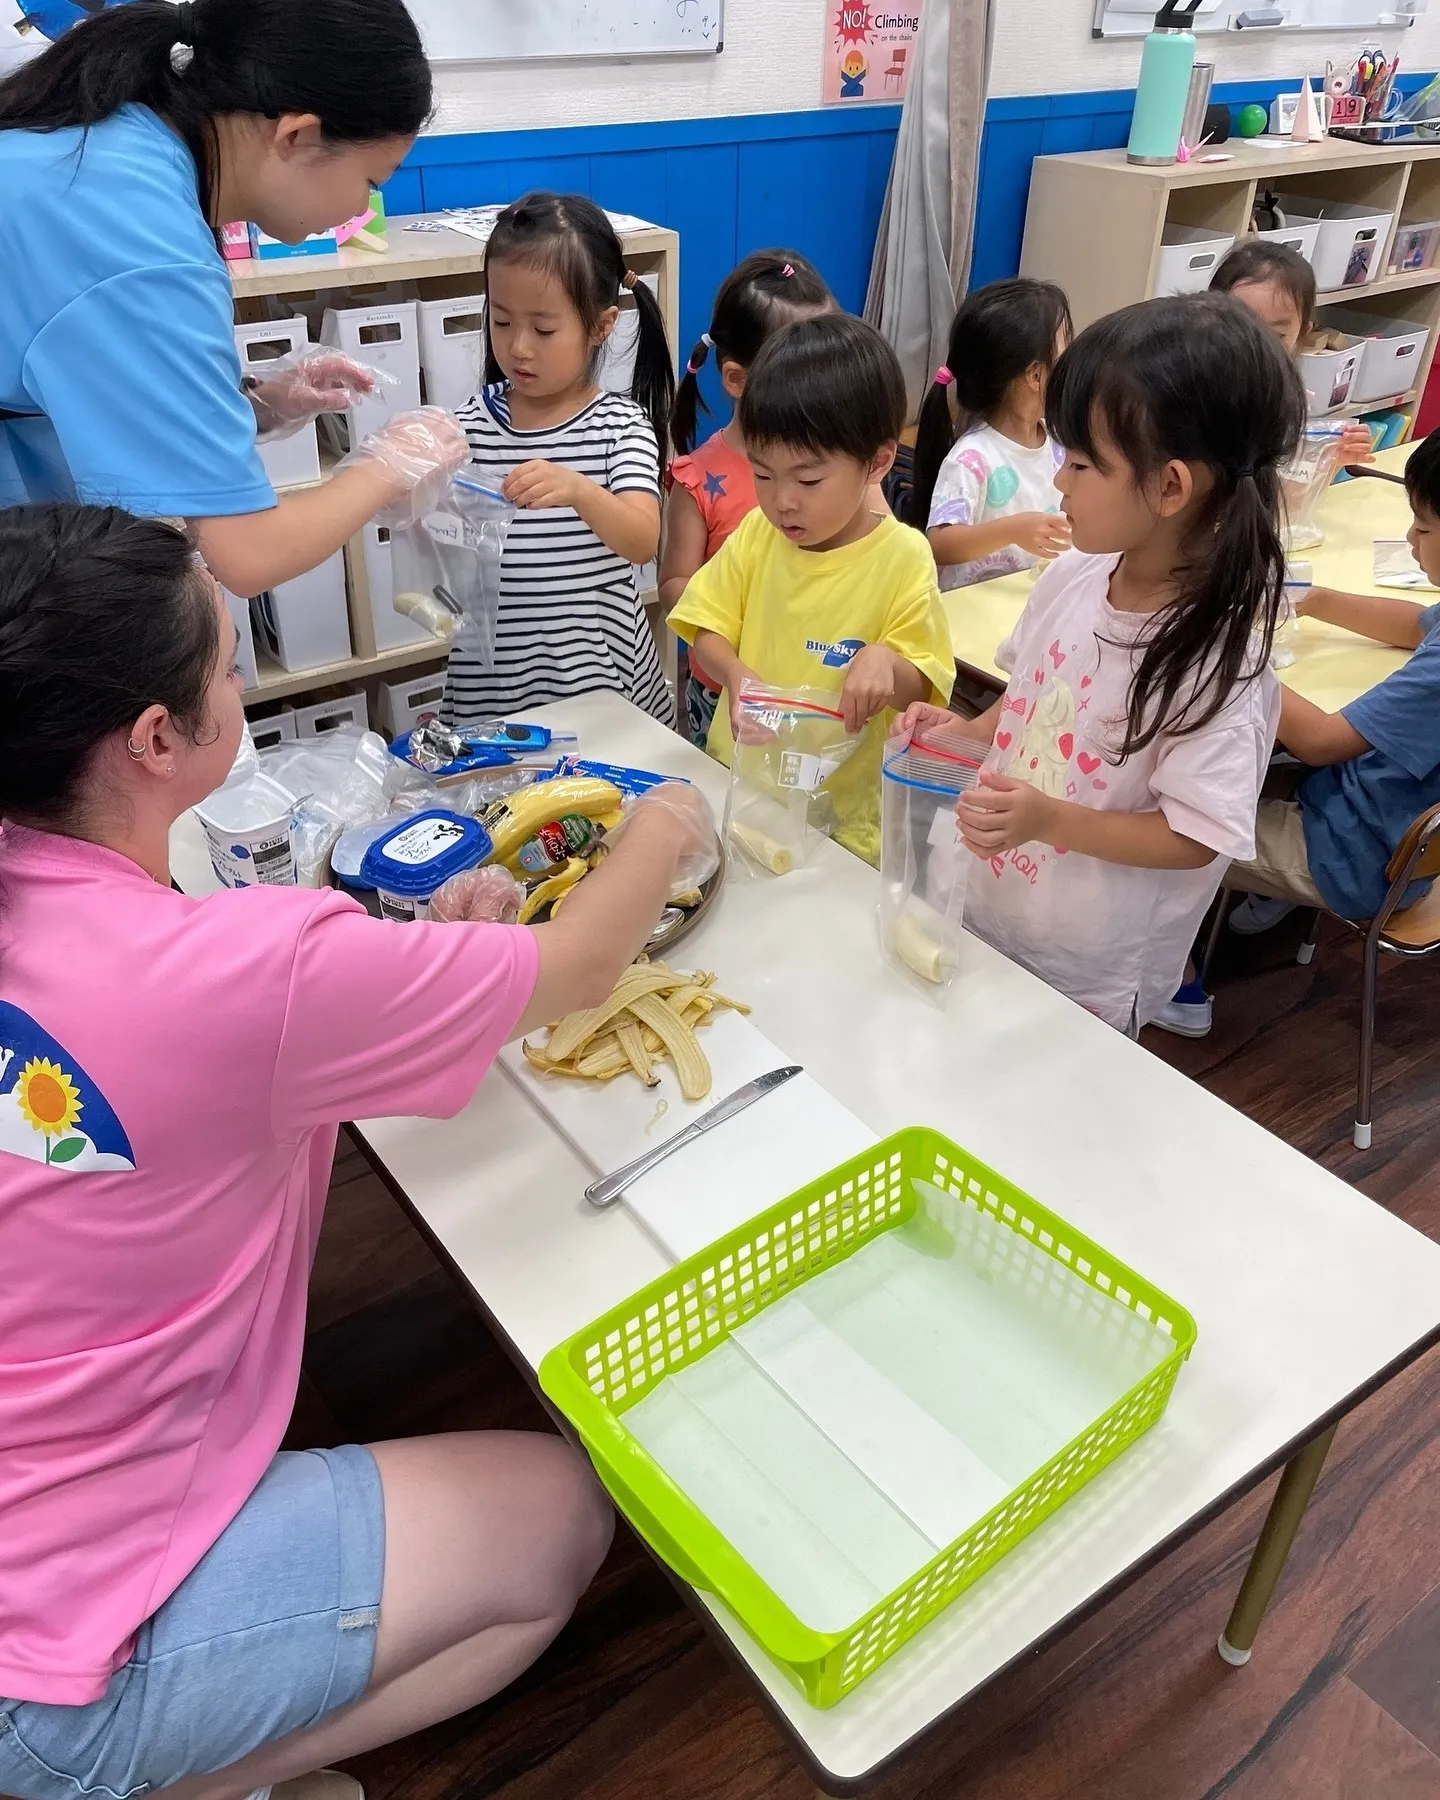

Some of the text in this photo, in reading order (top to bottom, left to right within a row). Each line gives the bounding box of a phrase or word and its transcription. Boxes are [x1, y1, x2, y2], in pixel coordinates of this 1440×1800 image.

[842, 8, 867, 29] NO!
[875, 14, 919, 32] Climbing
[1336, 99, 1357, 114] 19
[832, 643, 857, 658] Sky
